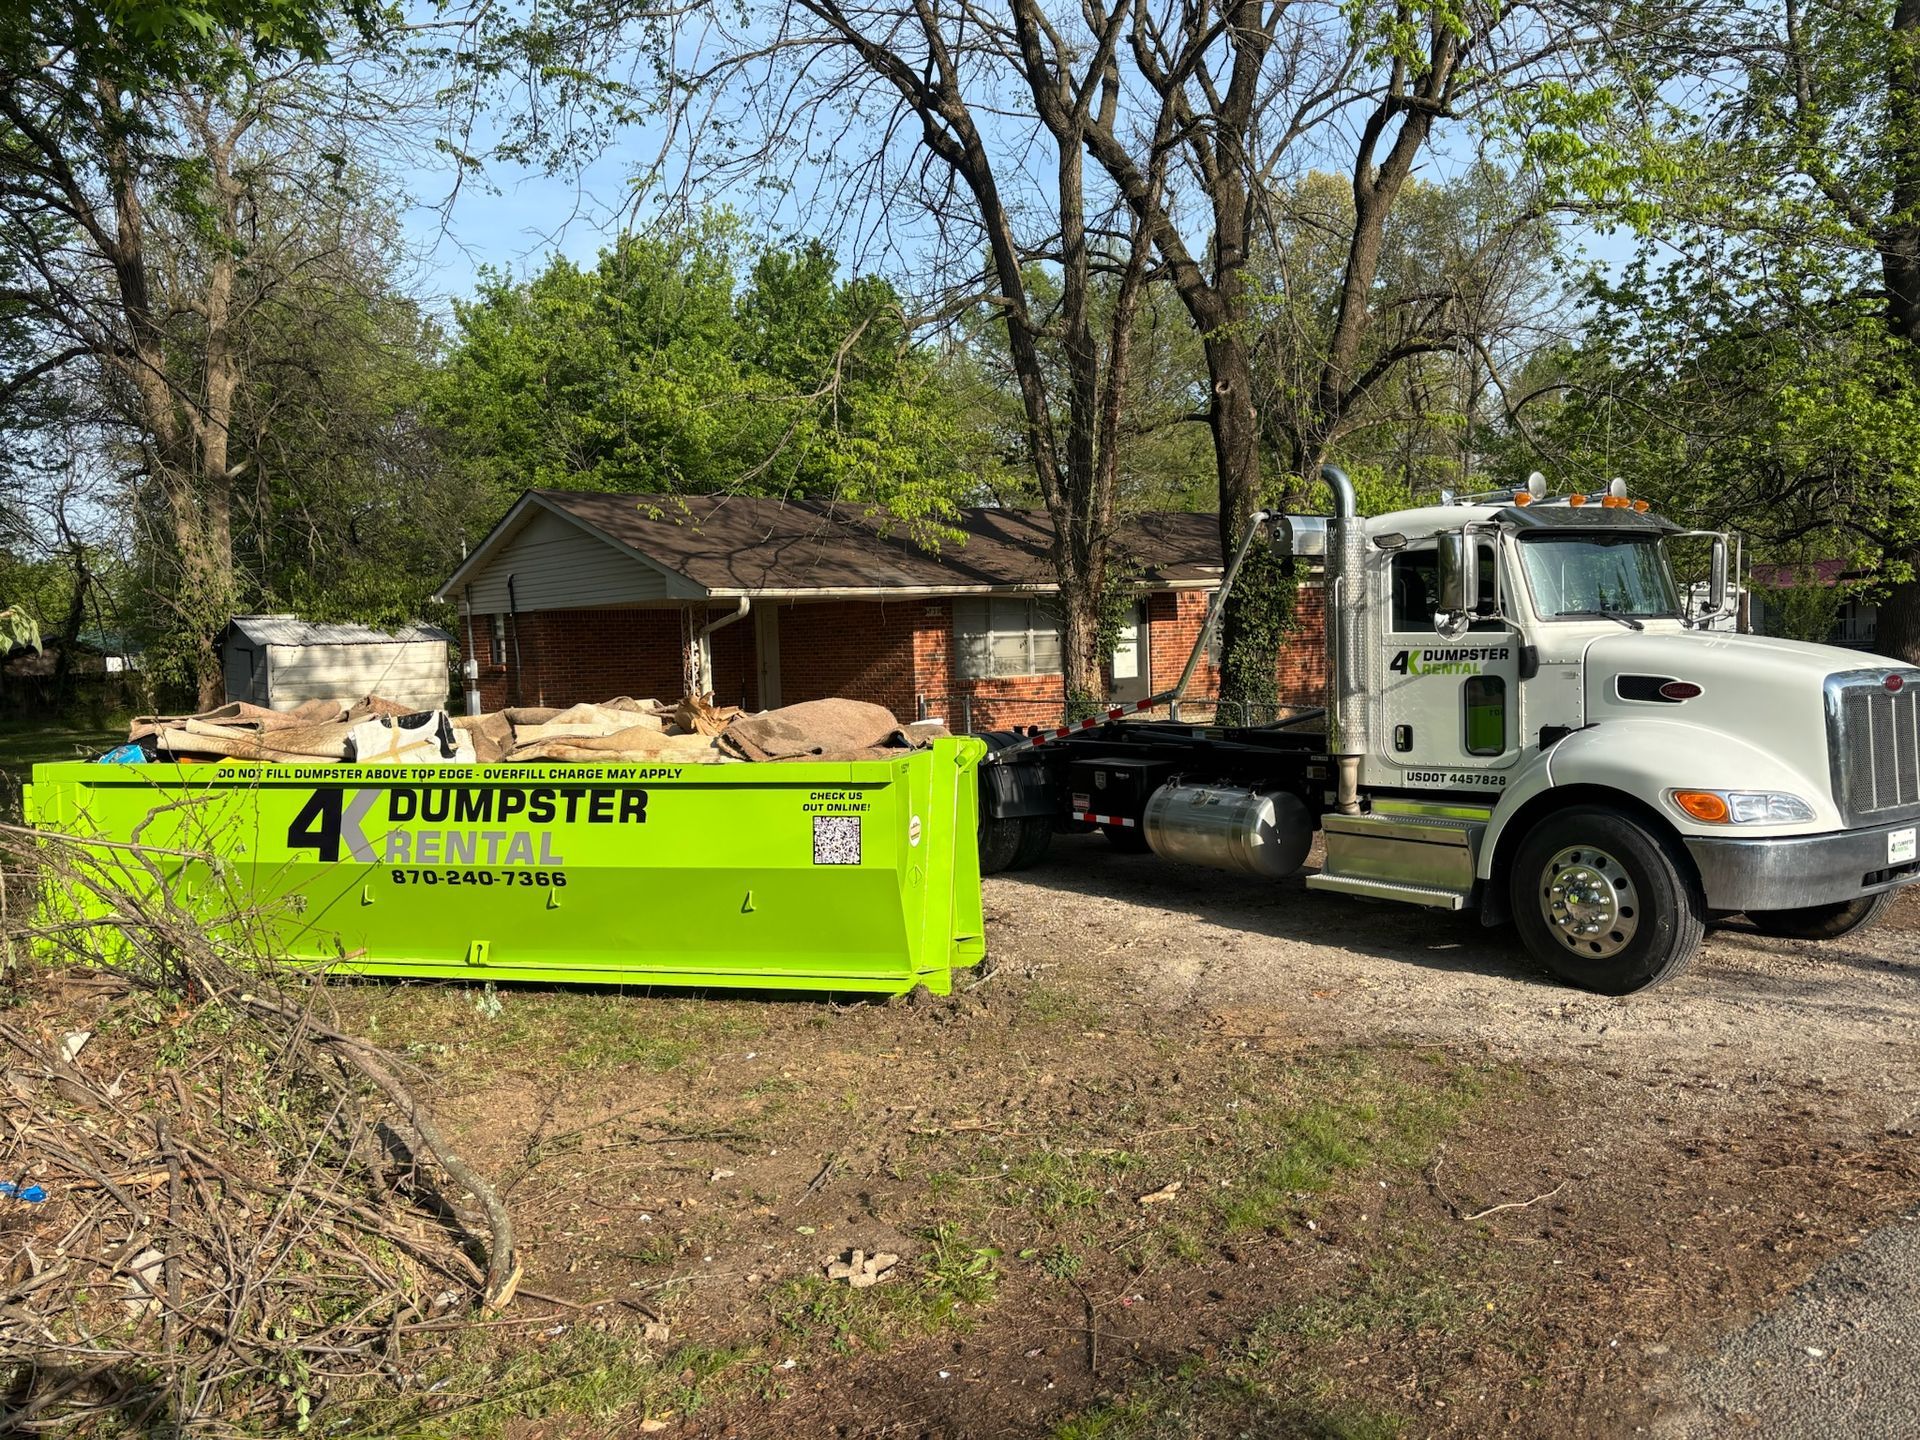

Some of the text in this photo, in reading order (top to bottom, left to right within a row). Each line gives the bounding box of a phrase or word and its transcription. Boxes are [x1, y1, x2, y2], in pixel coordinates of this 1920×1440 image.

[1389, 648, 1509, 675] 4K DUMPSTER
[1421, 663, 1481, 675] RENTAL
[218, 768, 234, 779] DO
[238, 768, 263, 779] NOT
[266, 768, 291, 779] FILL
[294, 768, 362, 779] DUMPSTER
[365, 768, 407, 779] ABOVE
[411, 768, 435, 779] TOP
[438, 768, 472, 779] EDGE
[483, 768, 545, 779] OVERFILL
[549, 768, 603, 779] CHARGE
[607, 768, 636, 779] MAY
[639, 768, 682, 779] APPLY
[1406, 771, 1506, 785] USDOT 4457828
[810, 792, 863, 800] CHECK US
[802, 803, 871, 811] OUT ONLINE!
[286, 788, 649, 863] 4K DUMPSTER
[385, 830, 564, 865] RENTAL
[391, 869, 567, 886] 870-240-7366
